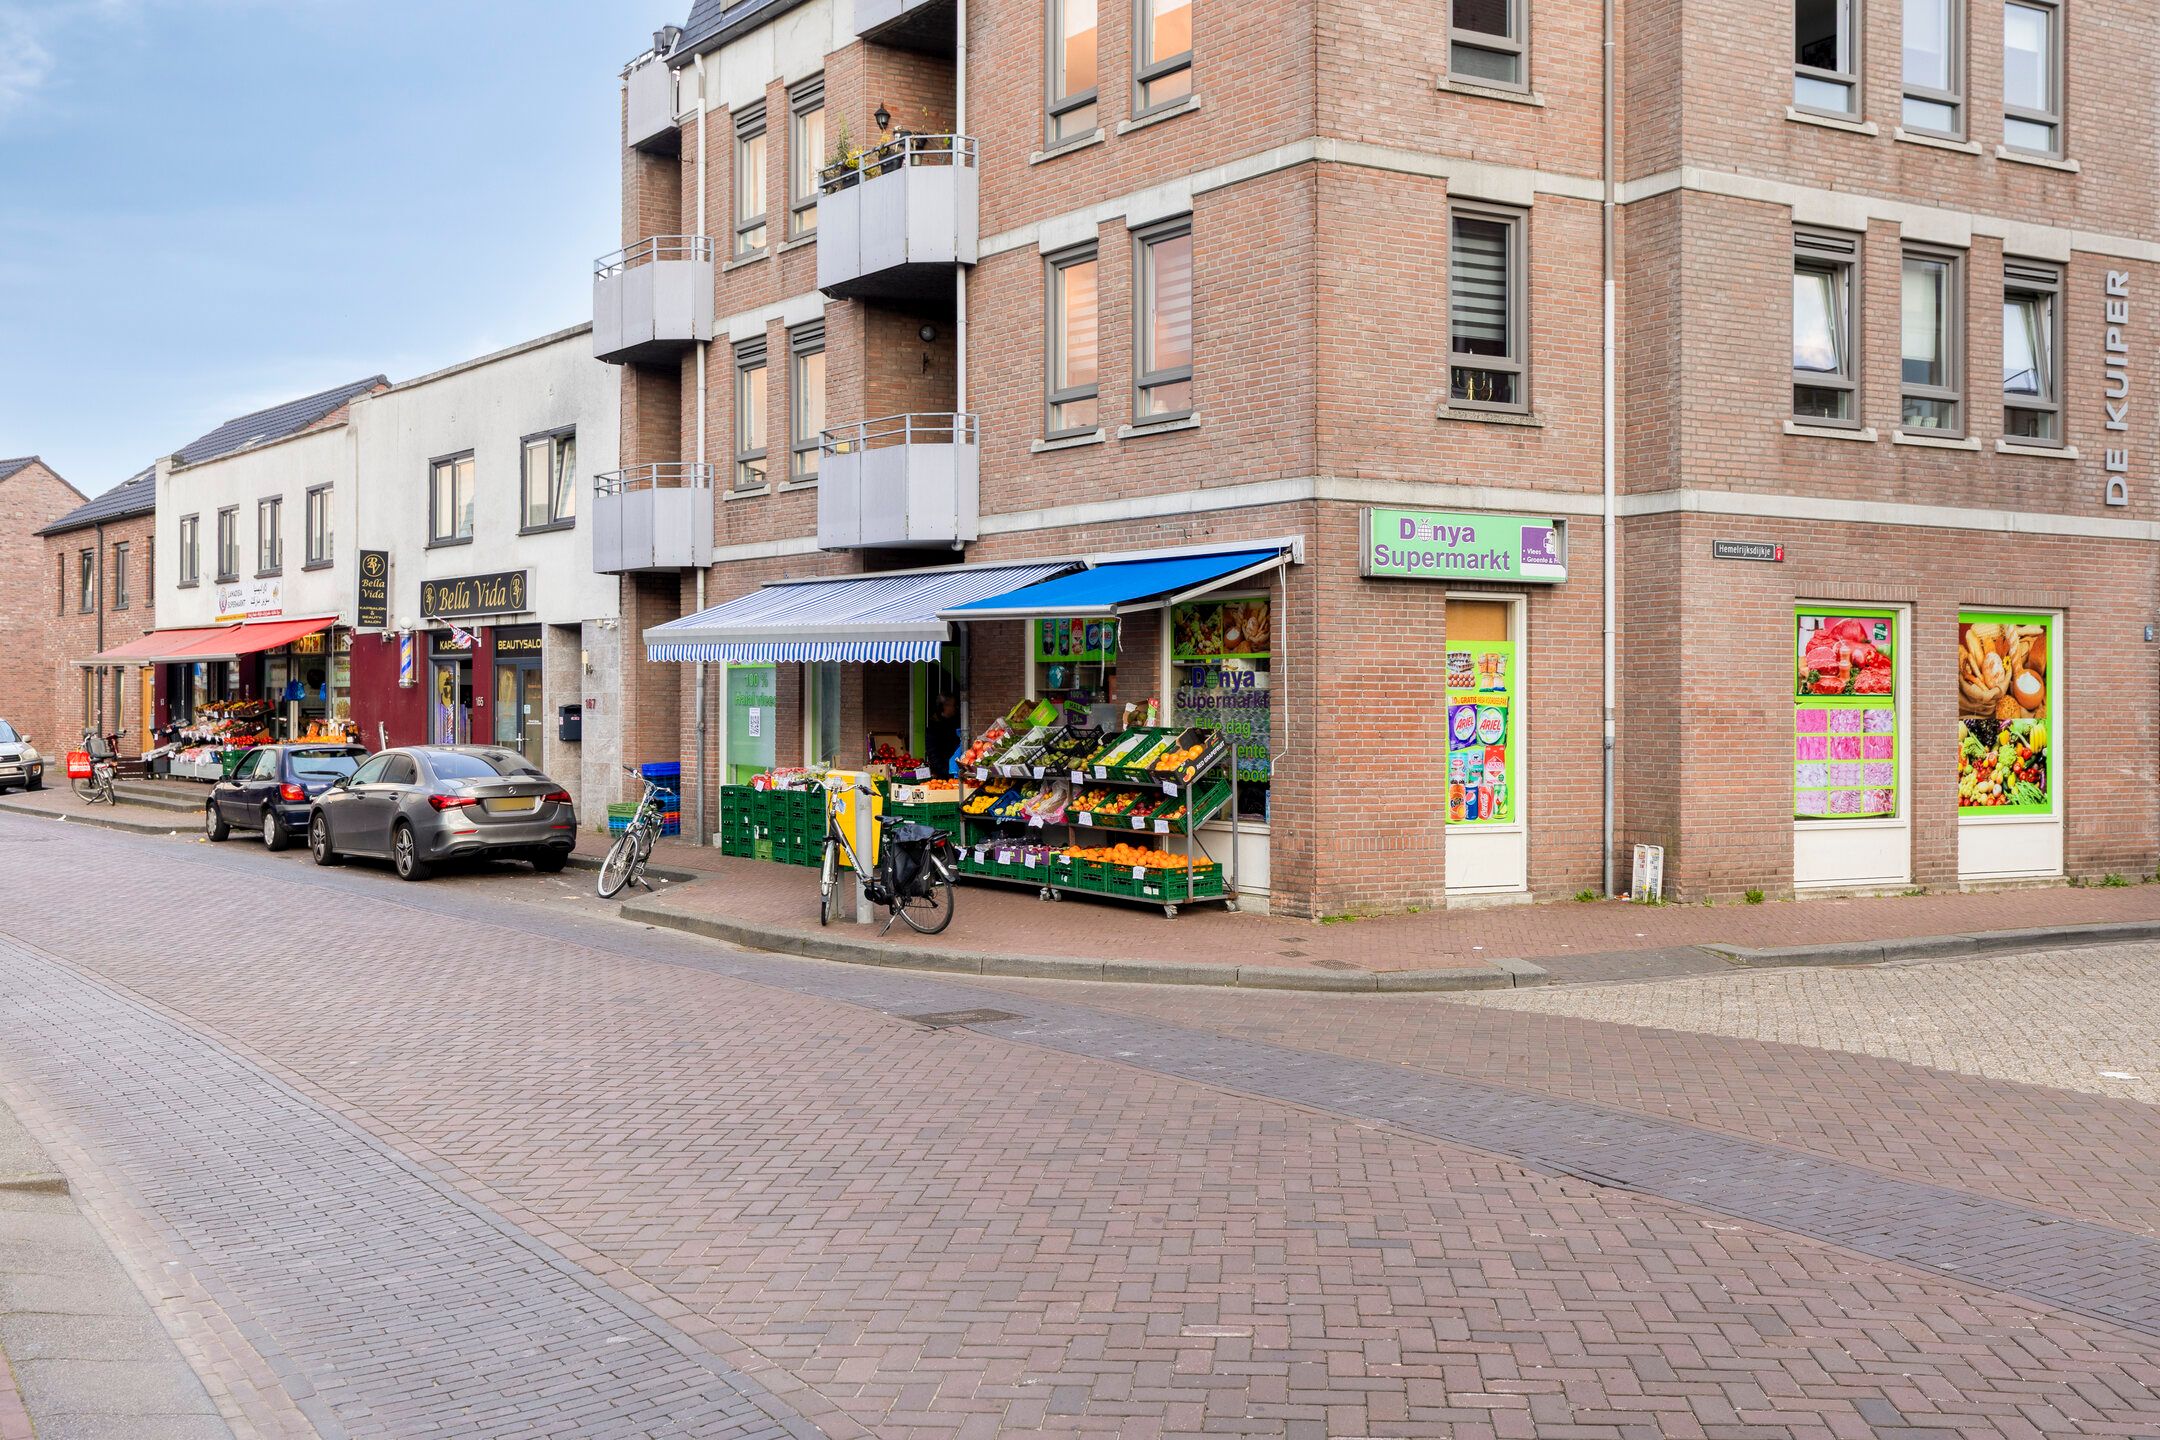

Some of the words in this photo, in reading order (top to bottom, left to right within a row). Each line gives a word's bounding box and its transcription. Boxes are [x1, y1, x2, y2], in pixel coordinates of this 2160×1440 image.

[2105, 269, 2129, 431] KUIPER
[2106, 448, 2129, 506] DE
[1374, 544, 1510, 572] Supermarkt
[1718, 544, 1771, 557] Hemelrijksdijkje
[1526, 556, 1548, 564] Groente
[361, 578, 385, 588] Bella
[361, 589, 385, 599] Vida
[438, 582, 470, 611] Bella
[473, 578, 507, 608] Vida
[497, 638, 542, 650] BEAUTYSALO
[1226, 718, 1251, 738] dag
[1456, 716, 1474, 731] ARIEL
[1479, 719, 1501, 731] ARIEL
[1196, 760, 1205, 770] RED
[1203, 740, 1225, 764] GRAPEFRUIT
[911, 791, 925, 800] UNO
